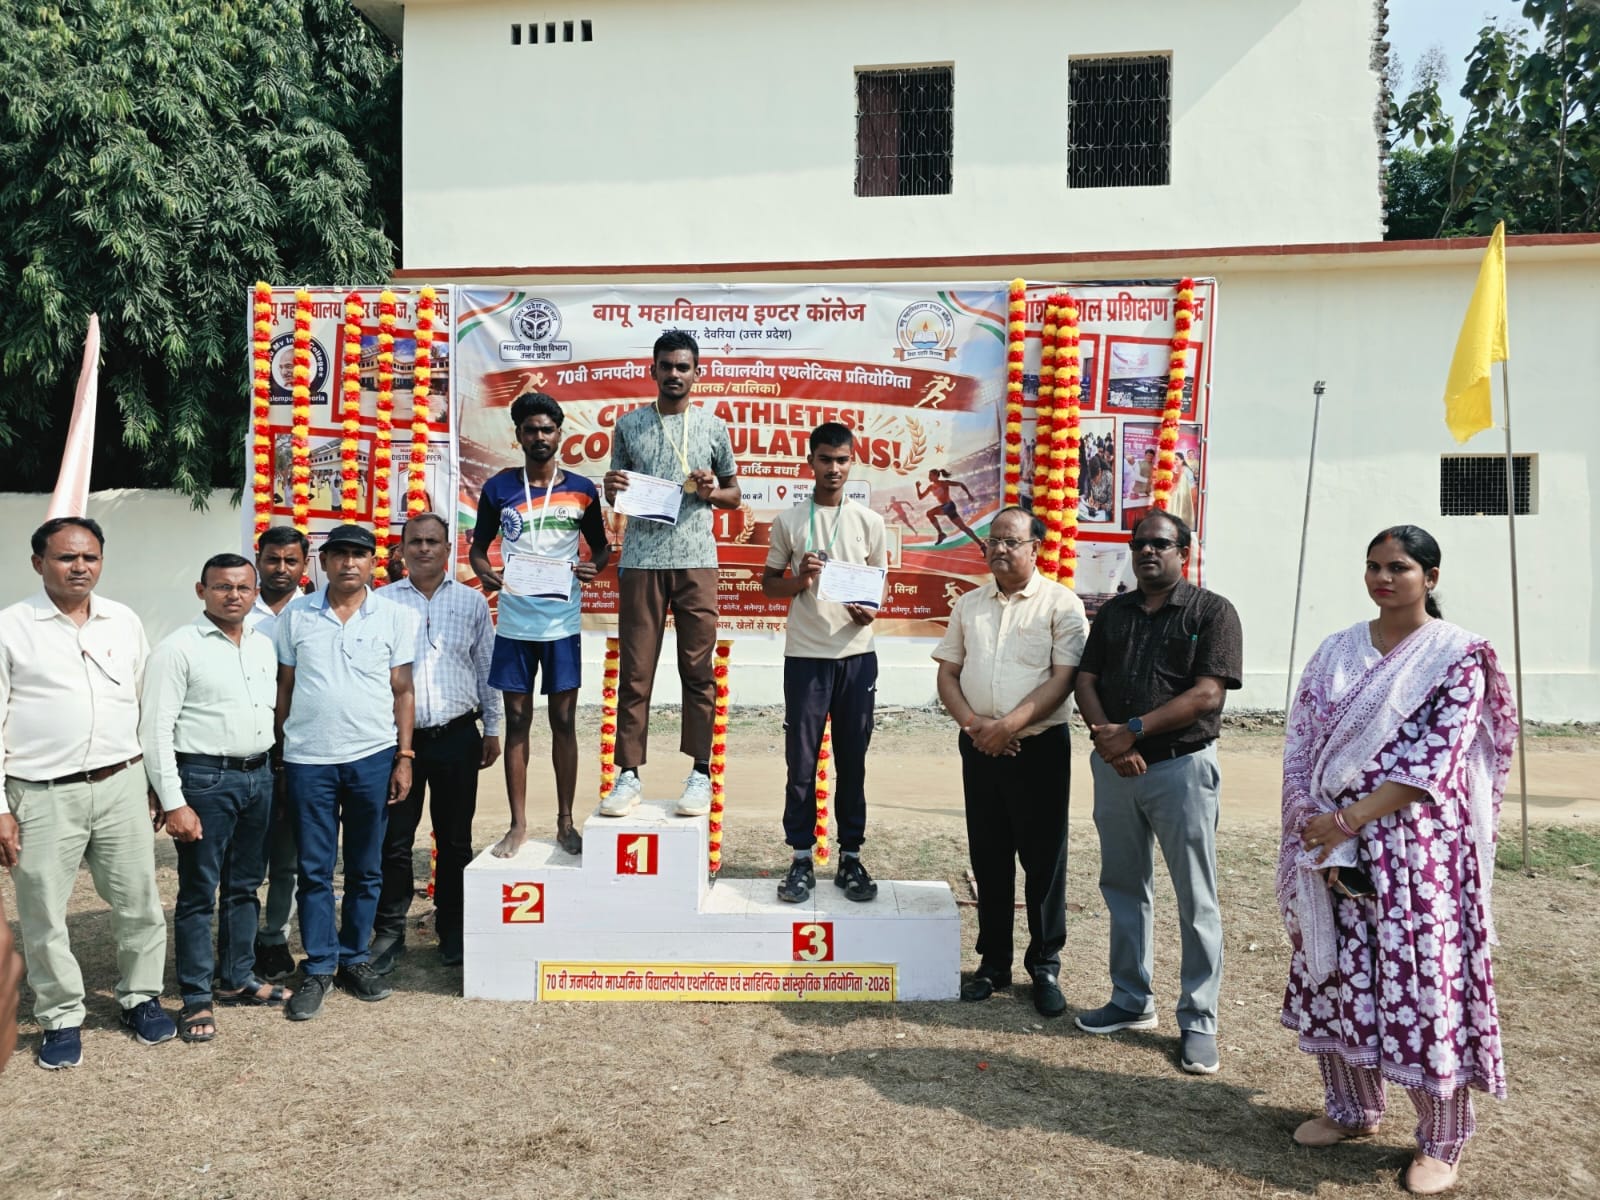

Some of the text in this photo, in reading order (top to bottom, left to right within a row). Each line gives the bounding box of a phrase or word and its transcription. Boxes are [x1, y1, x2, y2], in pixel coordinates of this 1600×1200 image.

[593, 297, 867, 328] बापू महाविद्यालय इण्टर कॉलेज
[1106, 292, 1168, 321] प्रशिक्षण
[704, 327, 735, 339] देवरिया
[739, 328, 762, 341] (उत्तर
[765, 328, 792, 341] प्रदेश)
[556, 366, 588, 385] 70वी
[591, 364, 645, 380] जनपदीय
[711, 360, 776, 379] विद्यालयीय
[779, 363, 842, 383] एथलेटिक्स
[845, 368, 912, 389] प्रतियोगिता
[690, 382, 781, 396] बालक/बालिका)
[714, 400, 865, 432] ATHLETES!
[741, 463, 801, 477] हार्दिक बधाई
[719, 513, 730, 538] 1
[718, 580, 763, 591] तोष चौरसि
[894, 582, 918, 595] सिन्हा
[626, 836, 649, 873] 1
[509, 884, 541, 921] 2
[798, 924, 828, 961] 3
[546, 974, 557, 990] 70
[569, 970, 603, 990] जनपदीय
[605, 971, 643, 991] माध्यमिक
[645, 971, 685, 991] विद्यालयीय
[687, 972, 728, 991] एथलेटिक्स
[730, 973, 740, 992] एवं
[782, 972, 822, 998] सांस्कृतिक
[823, 972, 863, 992] प्रतियोगिता
